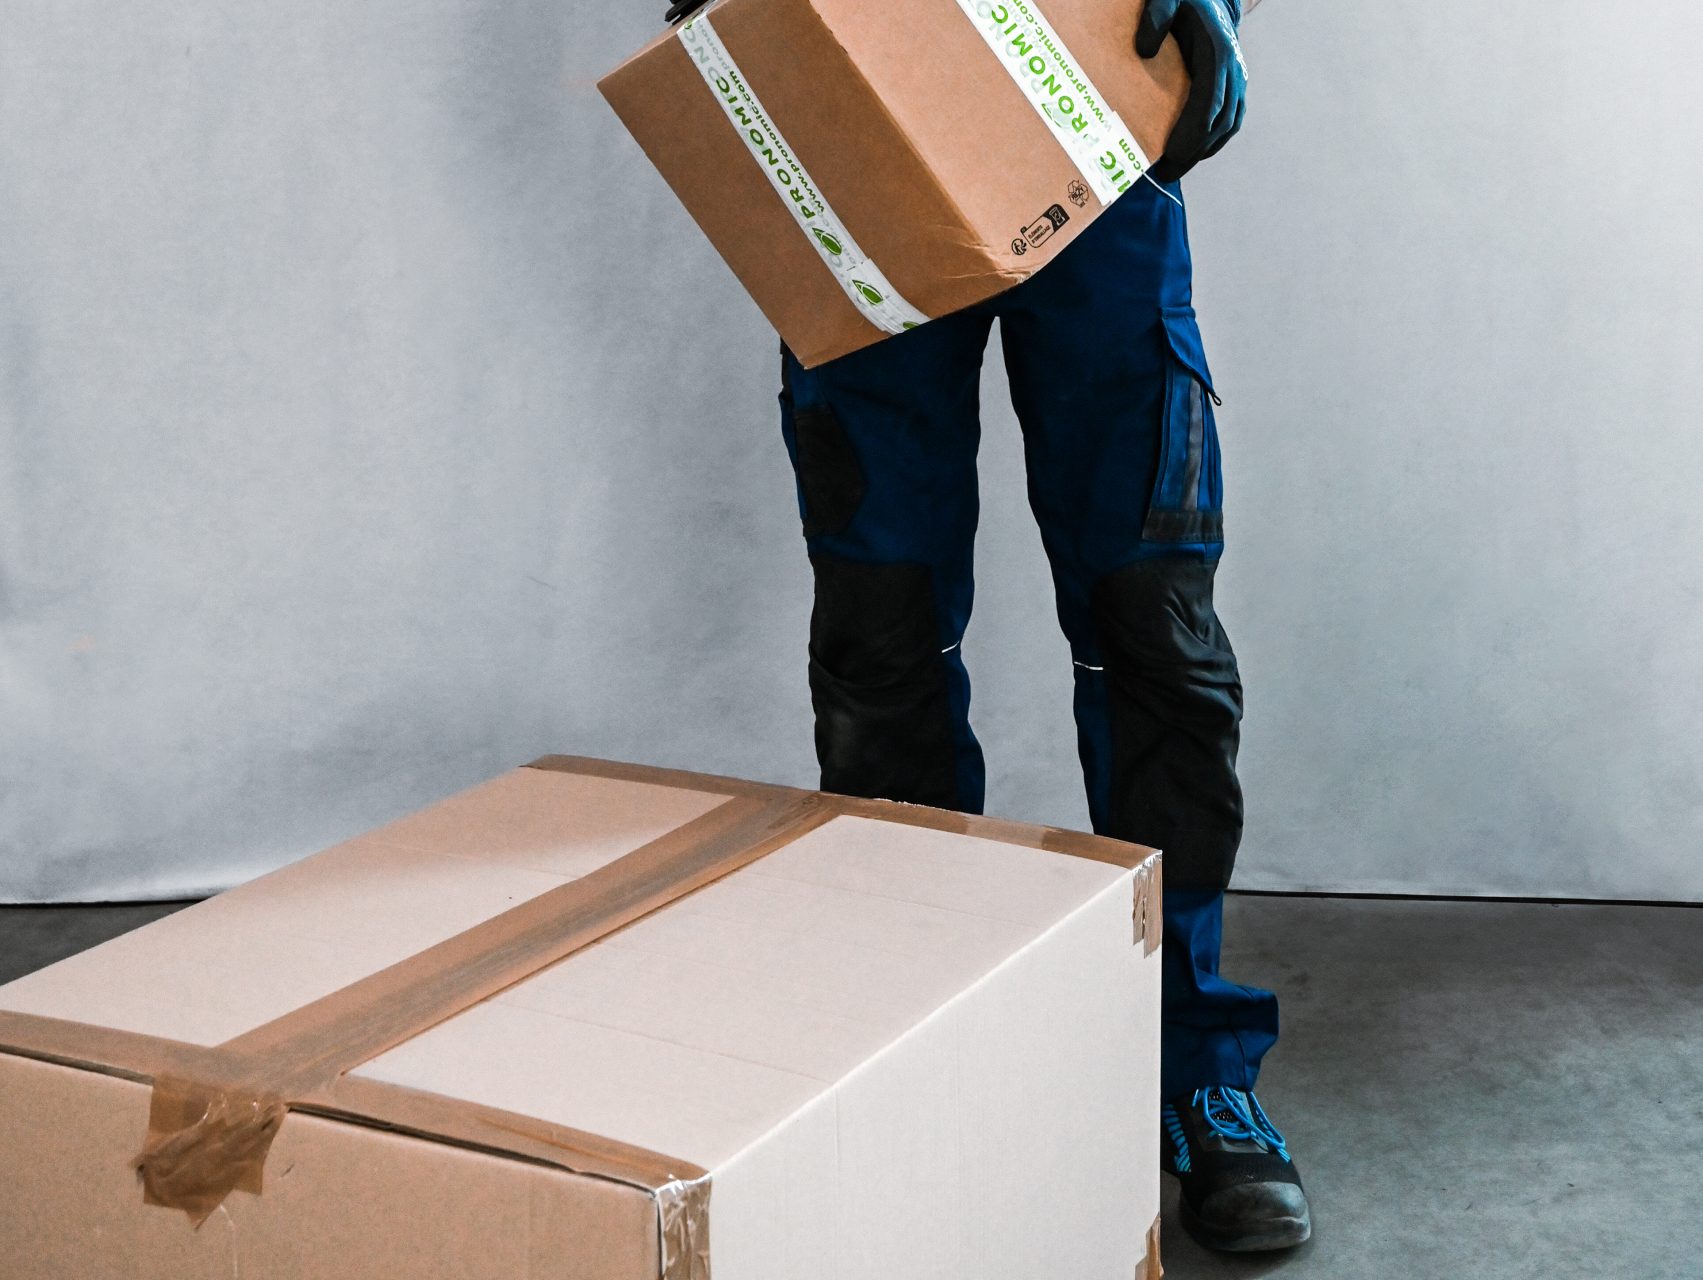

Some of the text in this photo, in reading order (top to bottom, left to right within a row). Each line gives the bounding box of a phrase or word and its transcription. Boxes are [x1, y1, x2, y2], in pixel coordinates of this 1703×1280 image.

[729, 70, 825, 213] www.pronomic.com
[991, 4, 1091, 139] RONOMIC
[715, 75, 816, 220] PRONOMIC
